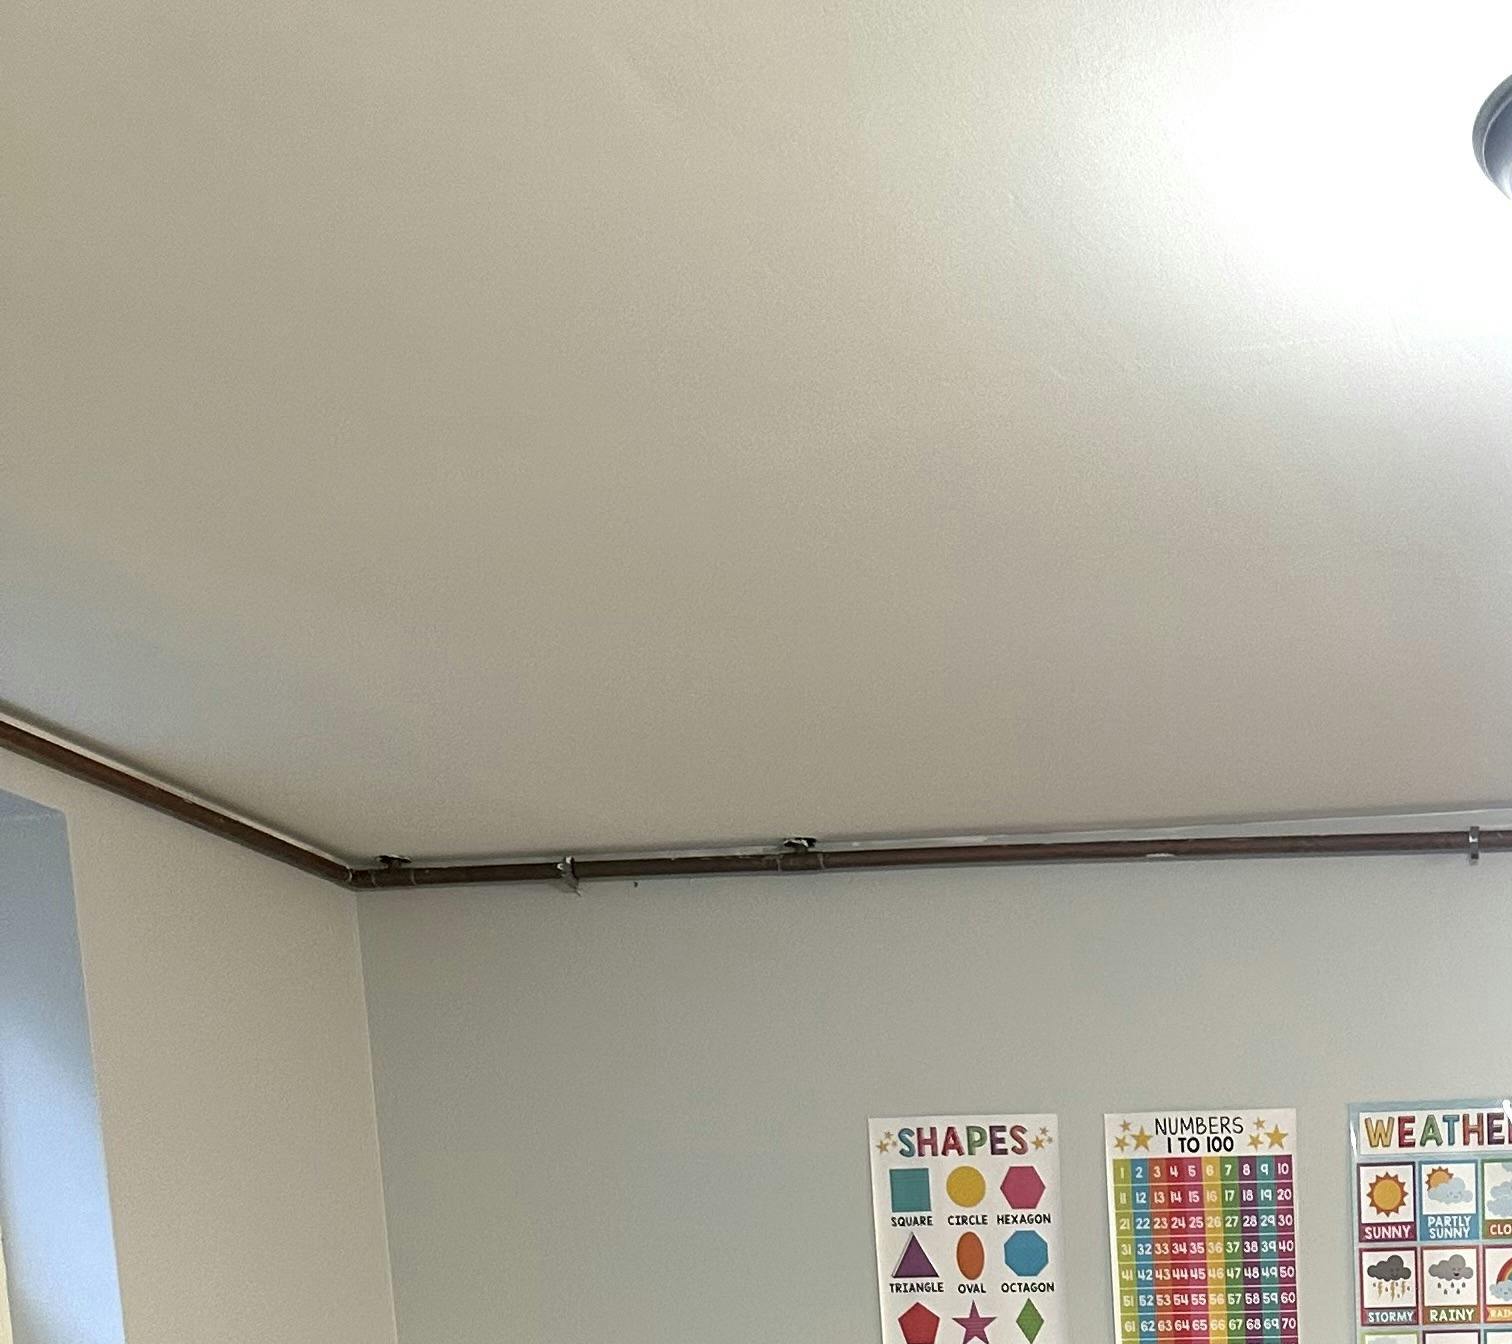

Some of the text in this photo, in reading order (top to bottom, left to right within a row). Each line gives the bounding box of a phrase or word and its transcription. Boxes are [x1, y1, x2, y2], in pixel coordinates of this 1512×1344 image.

[1154, 1117, 1244, 1135] NUMBERS
[898, 1124, 1029, 1158] SHAPES
[1178, 1137, 1197, 1153] TO
[1207, 1136, 1234, 1152] 100
[891, 1214, 933, 1227] SQUARE
[947, 1214, 988, 1226] CIRCLE
[997, 1213, 1051, 1225] HEXAGON
[1427, 1216, 1471, 1228] PARTLY
[1365, 1225, 1411, 1239] SUNNY
[1429, 1227, 1470, 1239] SUNNY
[1279, 1266, 1294, 1278] 50
[889, 1281, 944, 1294] TRIANGLE
[1001, 1281, 1054, 1293] OCTAGON
[1368, 1311, 1414, 1323] STORMY
